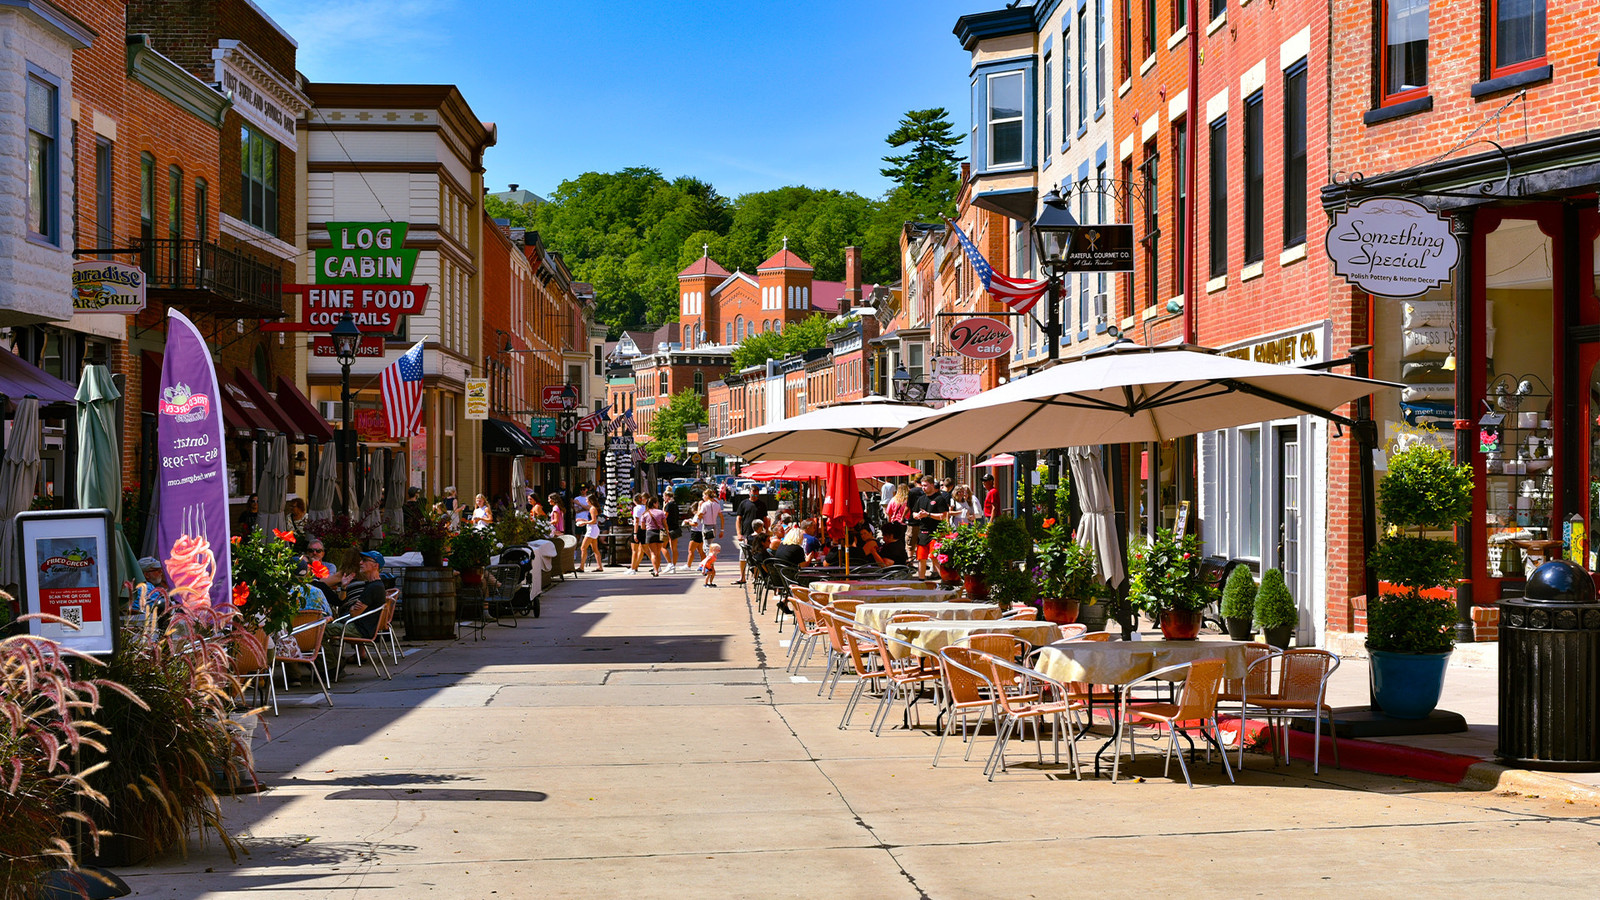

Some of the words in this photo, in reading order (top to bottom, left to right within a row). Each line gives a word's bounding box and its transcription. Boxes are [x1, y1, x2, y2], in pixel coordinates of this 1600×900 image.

[224, 69, 238, 93] FIRST
[238, 80, 253, 105] STATE
[253, 92, 263, 112] AND
[264, 100, 283, 126] SAVINGS
[284, 114, 295, 135] BANK
[341, 228, 392, 250] LOG
[1338, 219, 1445, 258] Something
[324, 256, 402, 278] CABIN
[1348, 243, 1431, 273] Special
[72, 266, 141, 288] aradise
[1350, 272, 1369, 280] Polish
[1370, 273, 1392, 282] Pottery
[72, 298, 90, 309] AR
[94, 291, 141, 306] GRILL
[309, 289, 354, 308] FINE
[362, 290, 415, 309] FOOD
[309, 312, 391, 325] COCTAILS
[950, 325, 1012, 350] Victory
[1414, 331, 1440, 346] BLESS
[317, 345, 379, 355] STEOUSE
[977, 344, 1002, 353] cafe
[46, 558, 66, 566] FRIED
